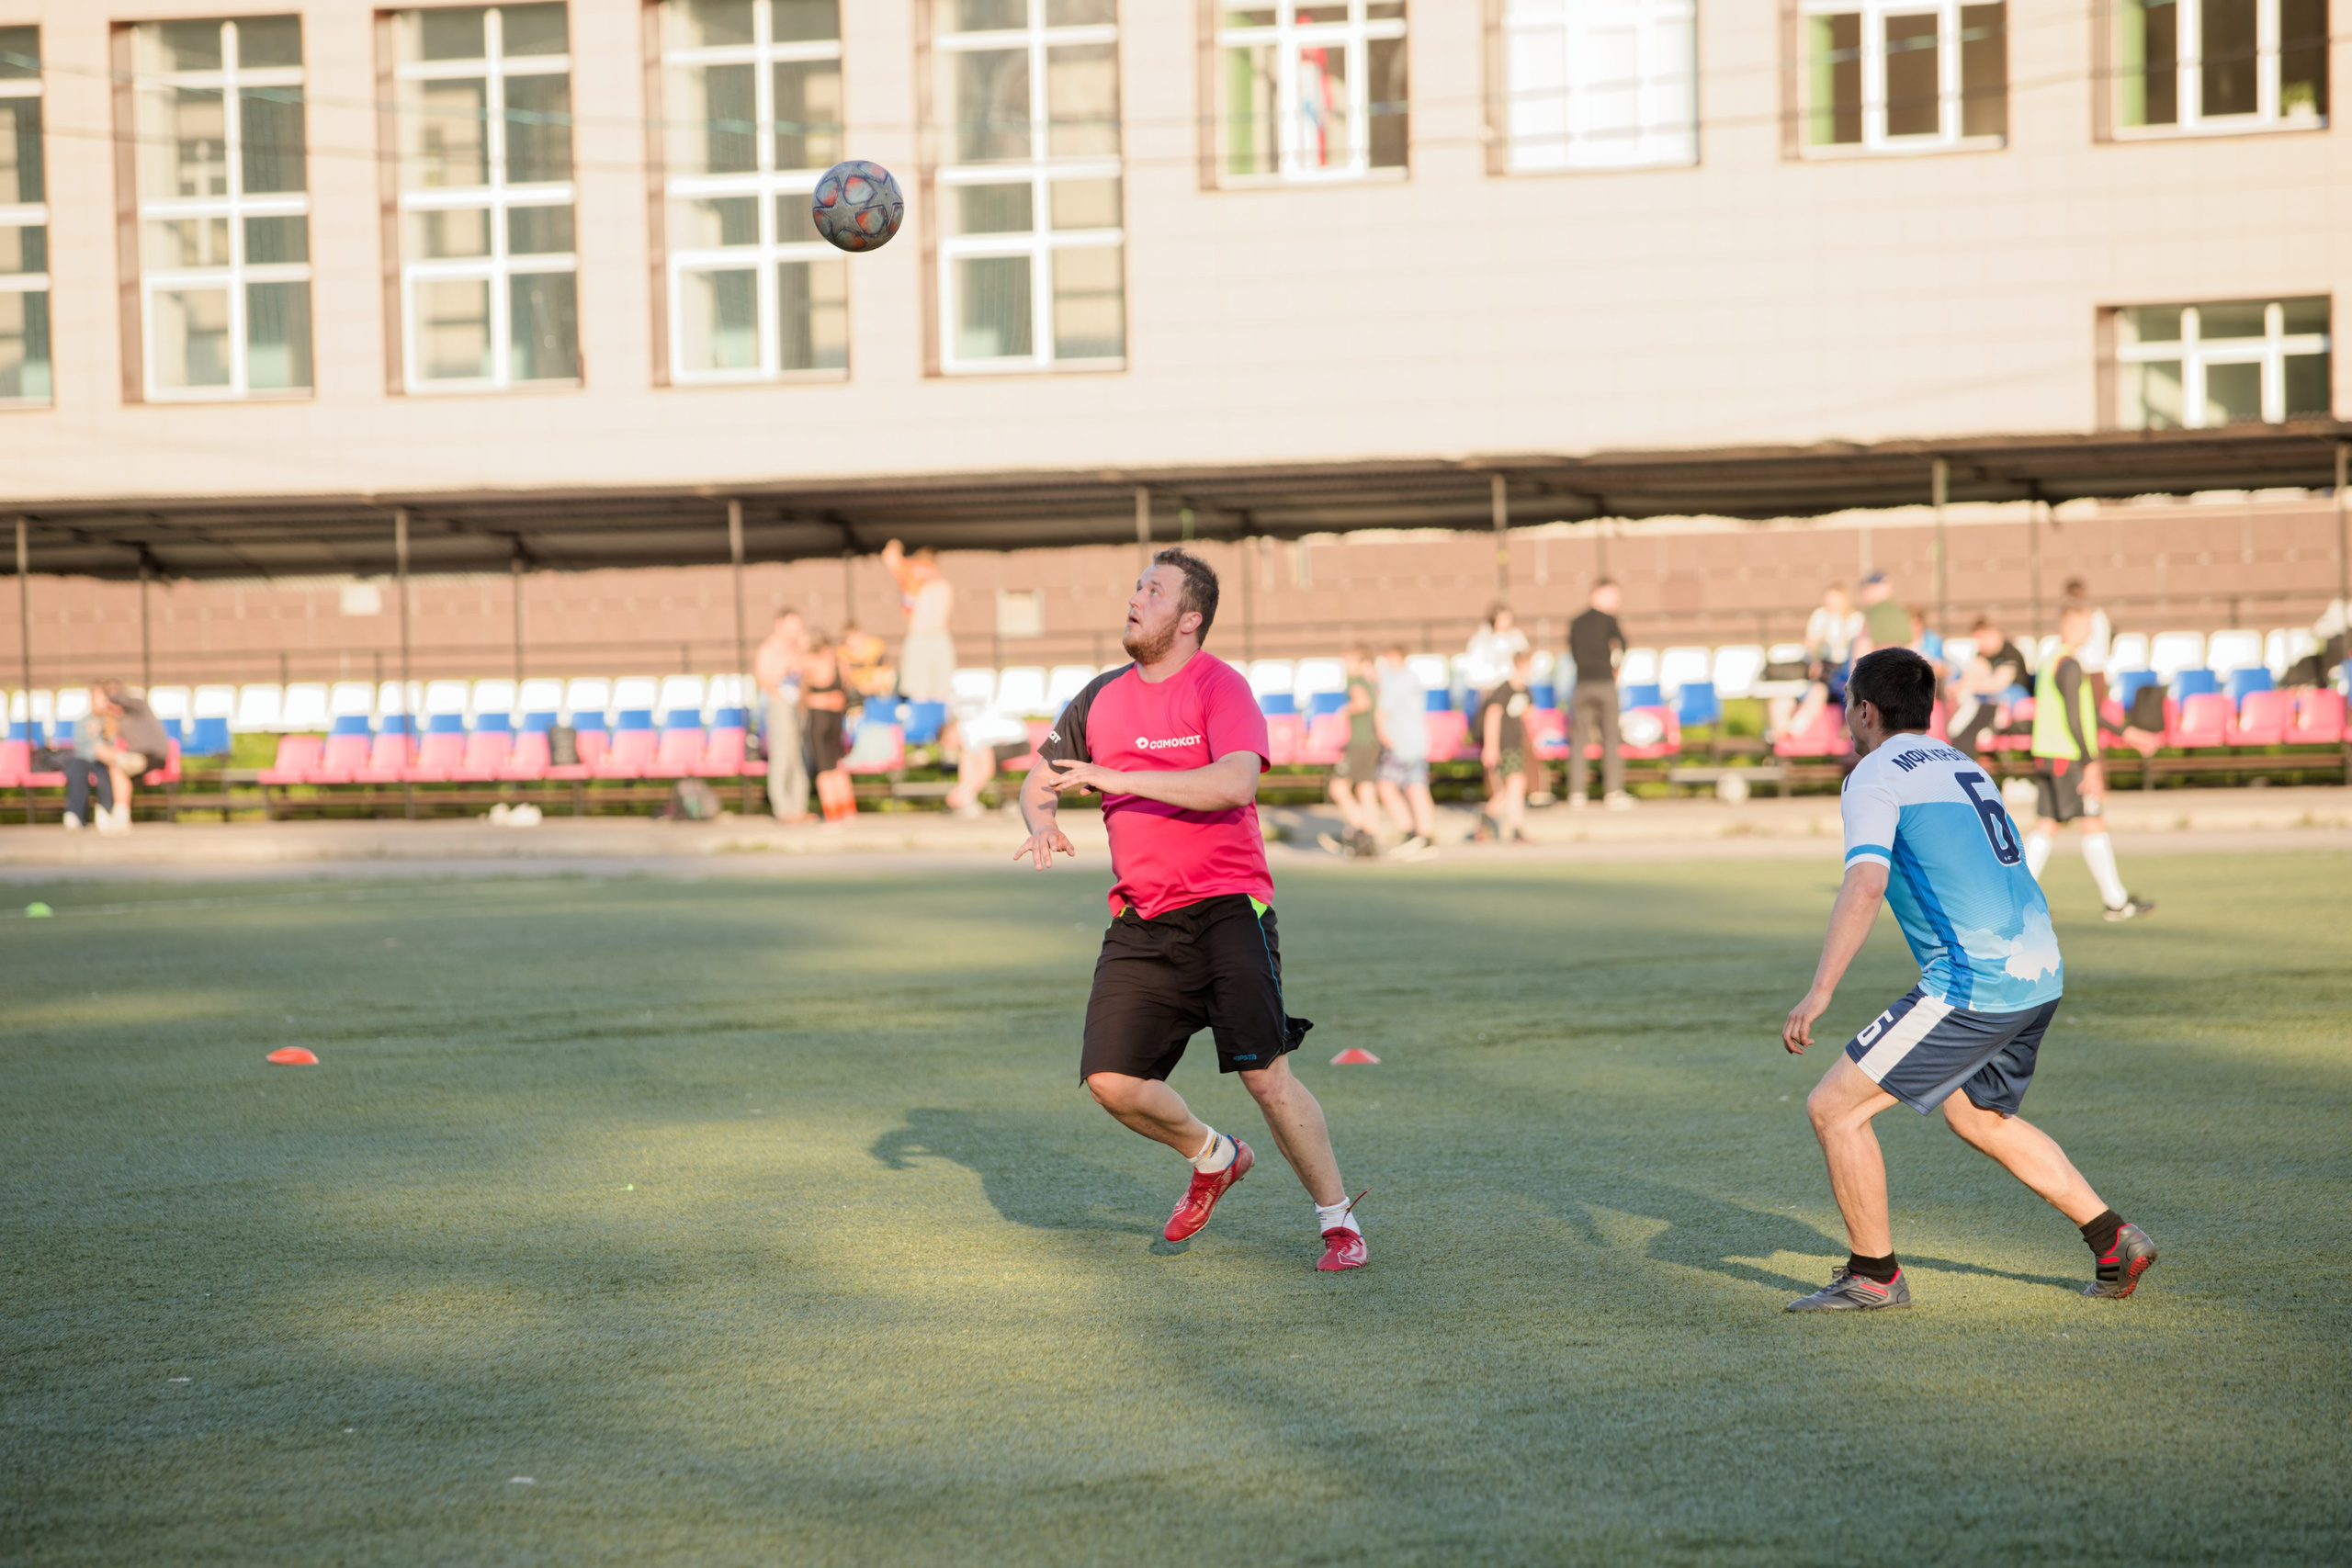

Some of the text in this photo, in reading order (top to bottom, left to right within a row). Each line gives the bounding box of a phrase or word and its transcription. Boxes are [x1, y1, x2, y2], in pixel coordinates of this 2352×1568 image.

[1891, 748, 1937, 773] МФК
[1954, 772, 2021, 866] 6
[1856, 1009, 1894, 1047] 6
